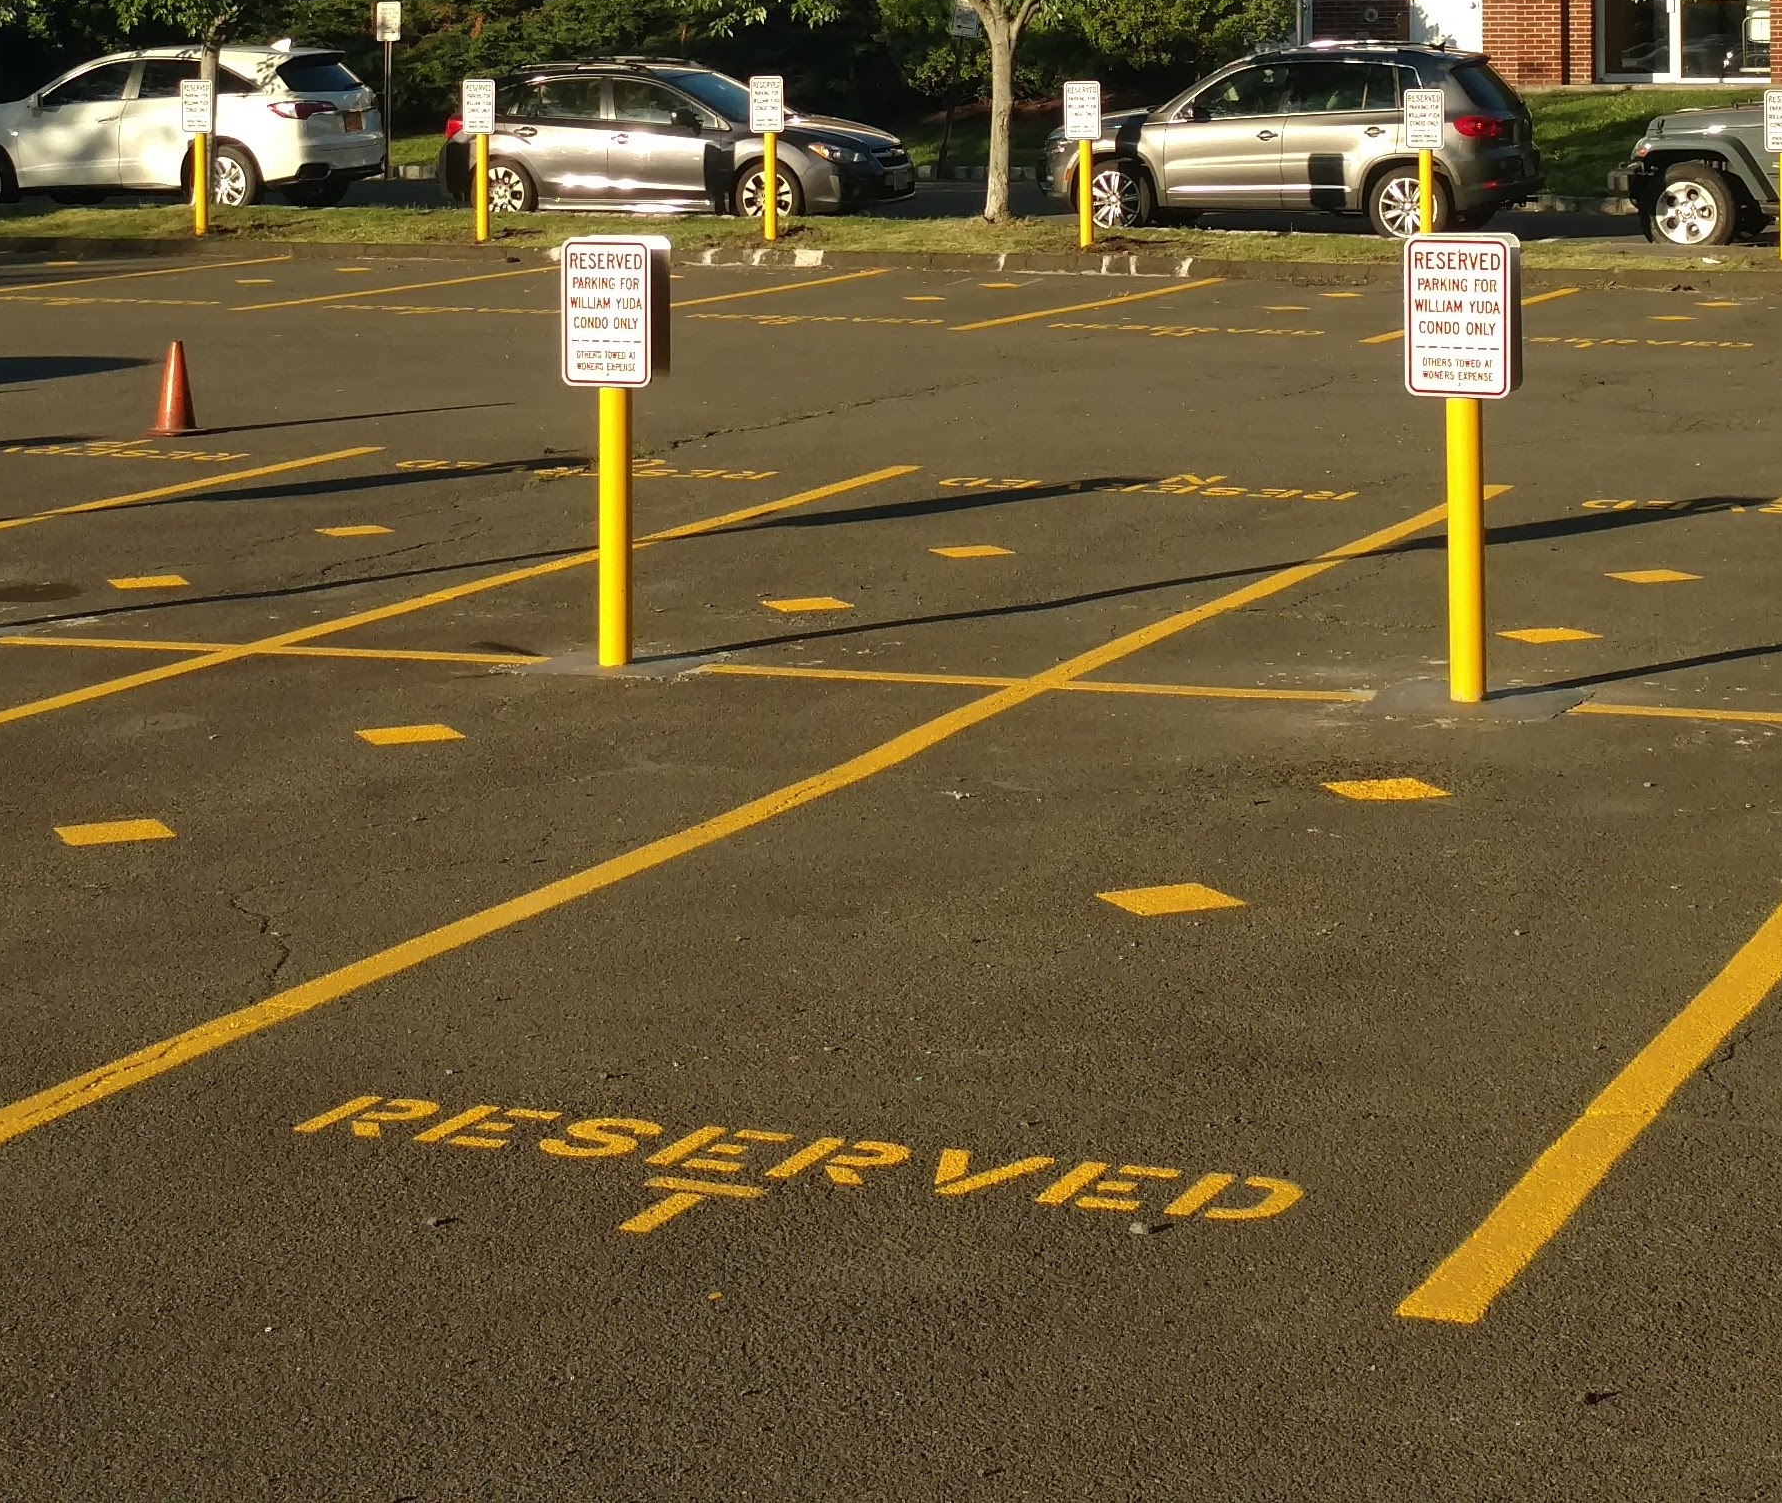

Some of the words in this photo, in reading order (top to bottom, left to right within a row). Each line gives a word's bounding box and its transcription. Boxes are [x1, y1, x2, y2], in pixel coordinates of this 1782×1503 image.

[1408, 94, 1441, 103] RESERVED
[569, 252, 643, 270] RESERVED
[1414, 251, 1501, 271] RESERVED
[572, 276, 616, 290] PARKING
[619, 276, 640, 290] FOR
[1417, 277, 1468, 293] PARKING
[1473, 277, 1498, 293] FOR
[570, 296, 611, 310] WILLIAM
[615, 296, 643, 310] YUDA
[1414, 299, 1463, 314] WILLIAM
[1469, 299, 1501, 314] YUDA
[573, 316, 609, 330] CONDO
[613, 316, 639, 330] ONLY
[1418, 320, 1460, 336] CONDO
[1465, 320, 1496, 336] ONLY
[576, 350, 602, 360] OTHERS
[604, 350, 627, 360] TOWED
[628, 350, 636, 360] AT
[1422, 357, 1453, 368] OTHERS
[1455, 357, 1482, 368] TOWED
[1484, 357, 1493, 368] AT
[1422, 370, 1455, 382] WONERS
[1457, 370, 1494, 382] EXPENSE
[293, 1095, 1306, 1225] RESERVED
[618, 1175, 767, 1234] T
